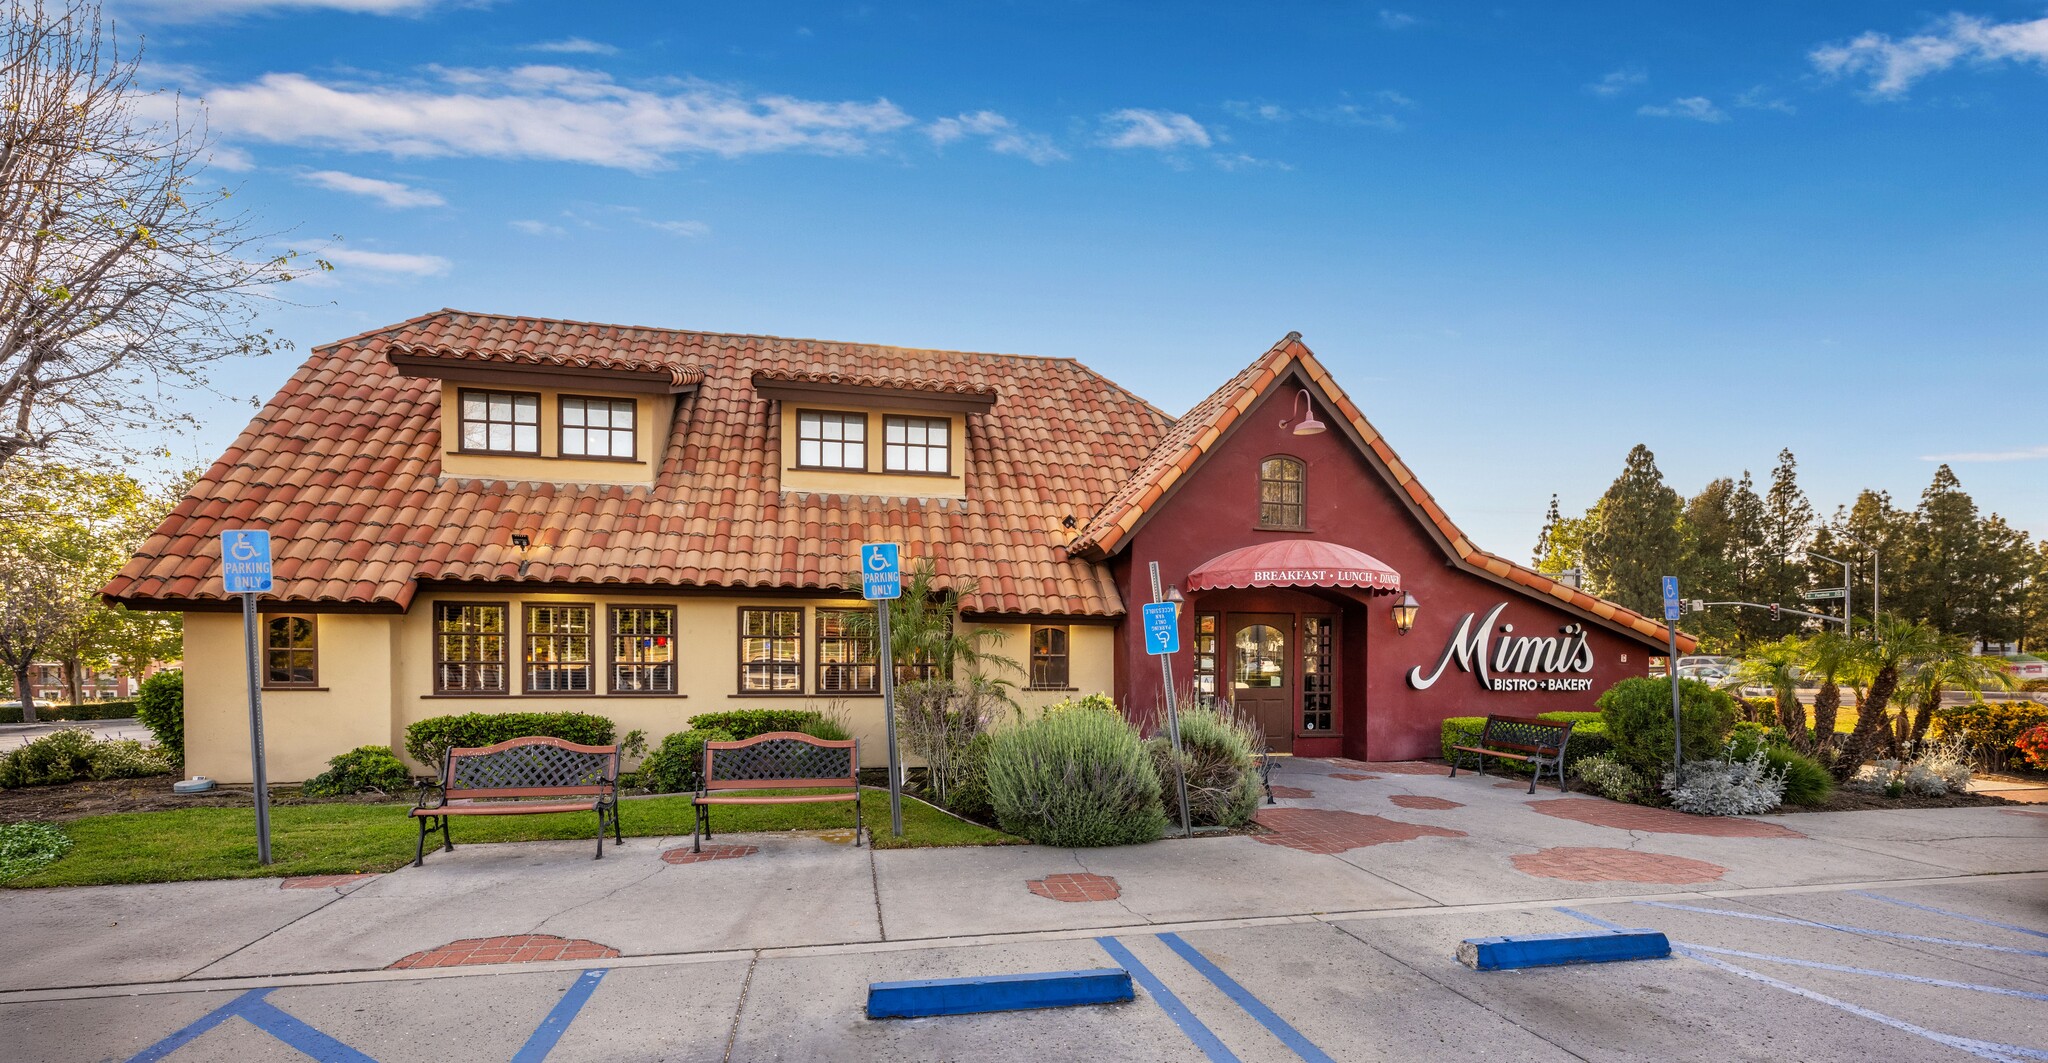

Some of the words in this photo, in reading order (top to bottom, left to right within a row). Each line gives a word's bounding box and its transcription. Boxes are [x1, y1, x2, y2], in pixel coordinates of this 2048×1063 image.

[225, 562, 270, 574] PARKING
[235, 576, 261, 588] ONLY
[864, 571, 899, 583] PARKING
[1254, 570, 1327, 581] BREAKFAST
[1338, 571, 1372, 582] LUNCH
[872, 584, 893, 596] ONLY
[1145, 607, 1174, 615] ACCESSIBLE
[1410, 602, 1594, 690] Mimi's
[1494, 678, 1538, 691] BISTRO
[1548, 678, 1593, 691] BAKERY
